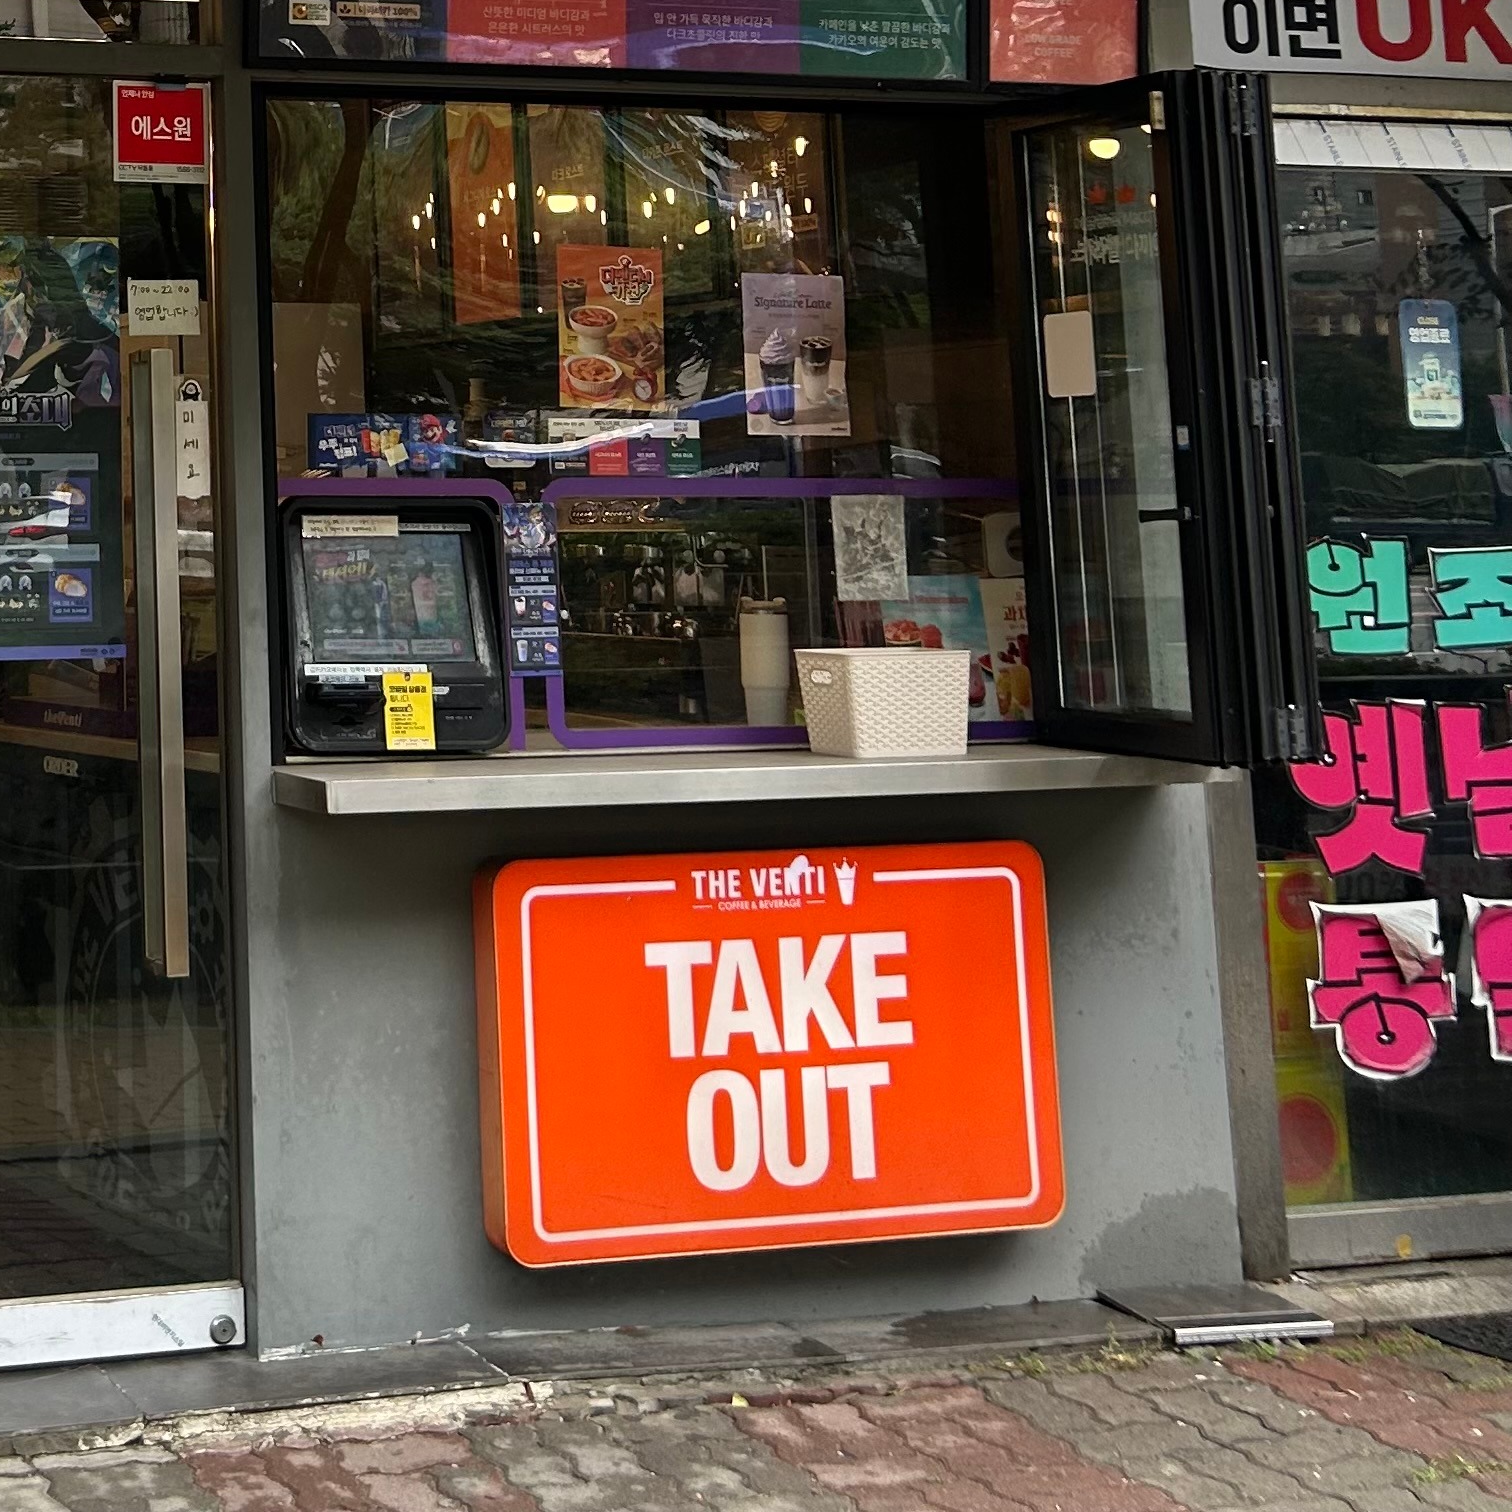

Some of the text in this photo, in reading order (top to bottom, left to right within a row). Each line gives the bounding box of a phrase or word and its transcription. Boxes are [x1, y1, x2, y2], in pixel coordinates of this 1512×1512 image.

[131, 115, 192, 142] 에스원
[754, 295, 832, 310] Signature Latte
[1306, 534, 1512, 656] 원조
[691, 865, 826, 900] THE VENTI
[643, 930, 914, 1058] TAKE
[1308, 899, 1512, 1079] 통
[686, 1061, 891, 1191] OUT
